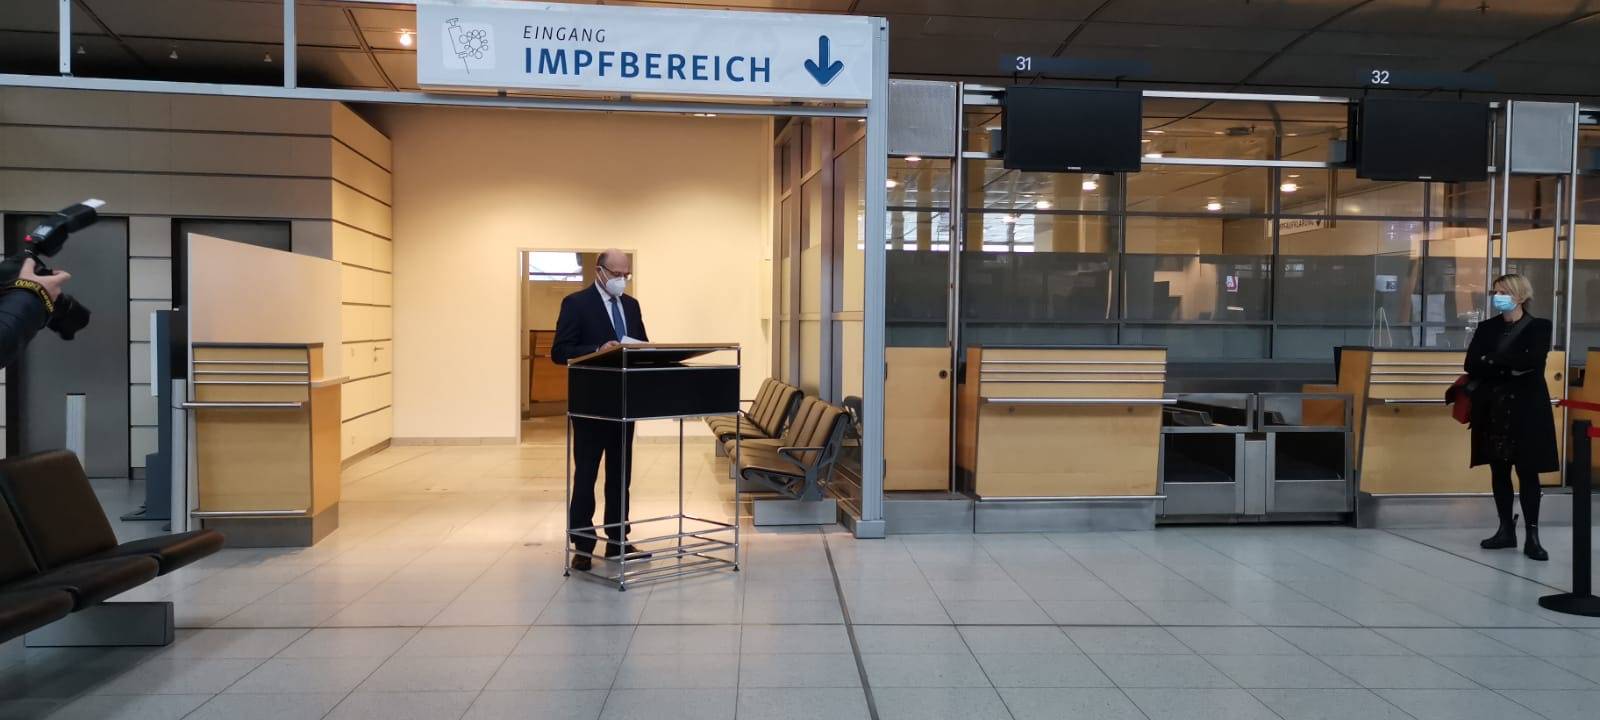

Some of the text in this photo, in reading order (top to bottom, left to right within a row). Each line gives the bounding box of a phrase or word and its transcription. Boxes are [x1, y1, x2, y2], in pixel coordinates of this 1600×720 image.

[523, 25, 606, 42] EINGANG
[524, 47, 771, 83] IMPFBEREICH
[1016, 56, 1031, 70] 31
[1371, 70, 1390, 84] 32
